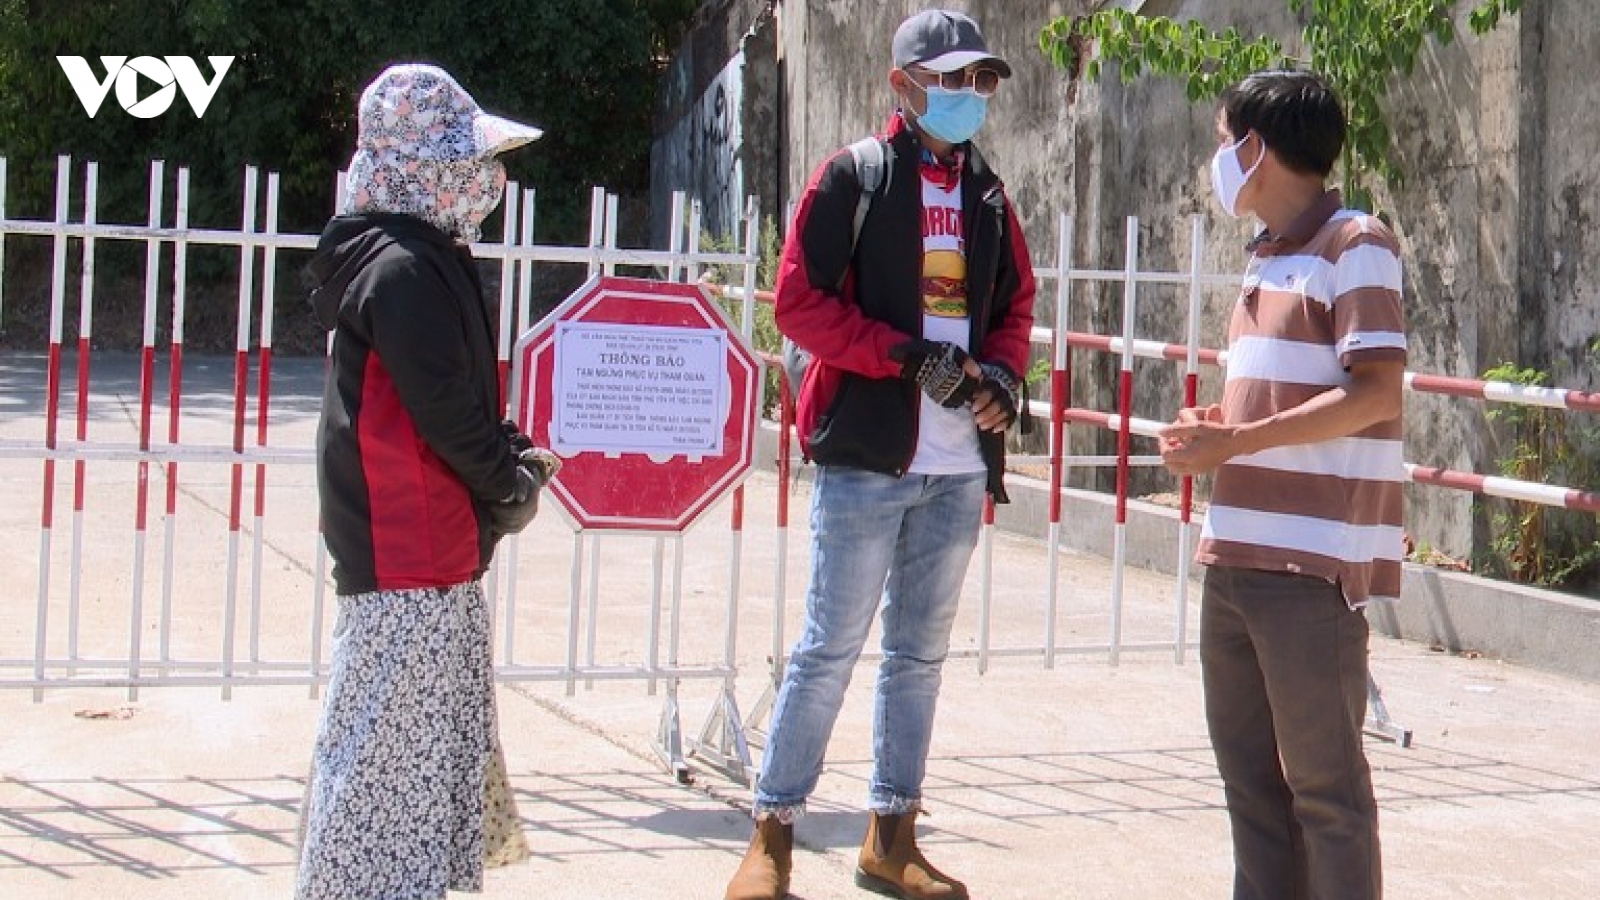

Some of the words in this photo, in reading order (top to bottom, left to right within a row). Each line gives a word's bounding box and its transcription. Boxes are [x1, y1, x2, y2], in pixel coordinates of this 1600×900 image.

[600, 351, 650, 366] THÔNG
[660, 372, 682, 381] THAM
[683, 372, 705, 382] QUAN
